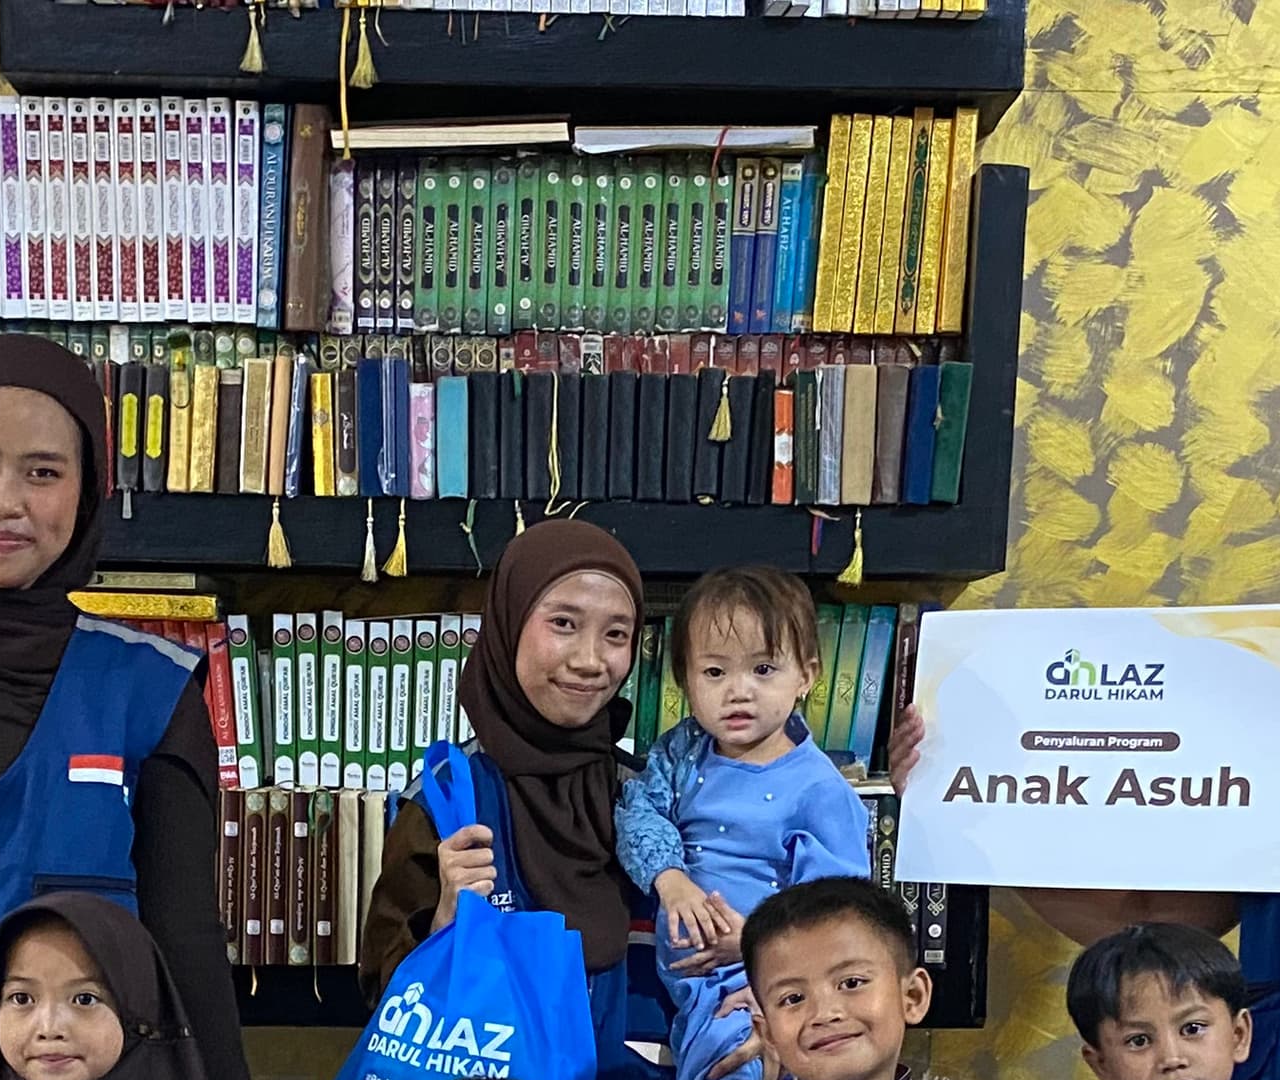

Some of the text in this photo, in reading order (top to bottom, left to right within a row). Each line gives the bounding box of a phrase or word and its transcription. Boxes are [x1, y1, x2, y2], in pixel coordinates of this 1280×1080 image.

[361, 218, 371, 268] AL-HAMID
[381, 218, 390, 269] AL-HAMID
[403, 219, 412, 270] AL-HAMID
[780, 197, 792, 251] AL-HAFIZ
[1045, 688, 1163, 701] DARUL HIKAM
[1100, 663, 1165, 686] LAZ
[1034, 734, 1163, 750] Penyaluran Program
[942, 766, 1251, 807] Anak Asuh
[367, 1032, 510, 1079] DARUL HIKAM
